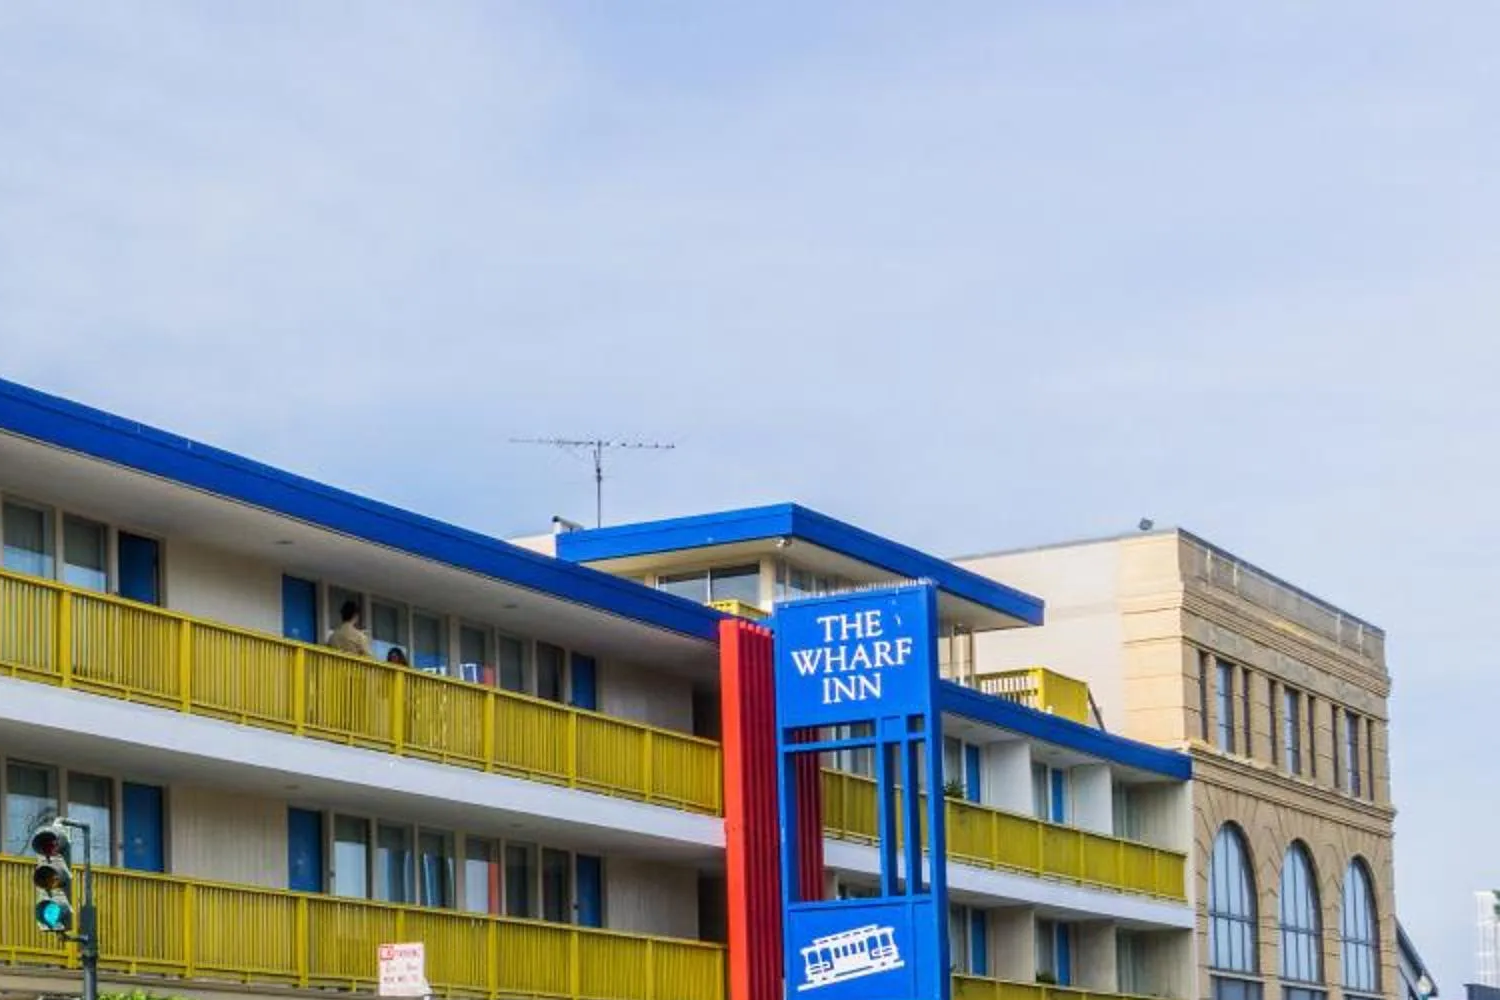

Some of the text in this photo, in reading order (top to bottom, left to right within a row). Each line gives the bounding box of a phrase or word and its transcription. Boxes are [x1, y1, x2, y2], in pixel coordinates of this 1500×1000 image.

[816, 609, 884, 642] THE
[790, 637, 913, 676] WHARF
[822, 672, 881, 704] INN
